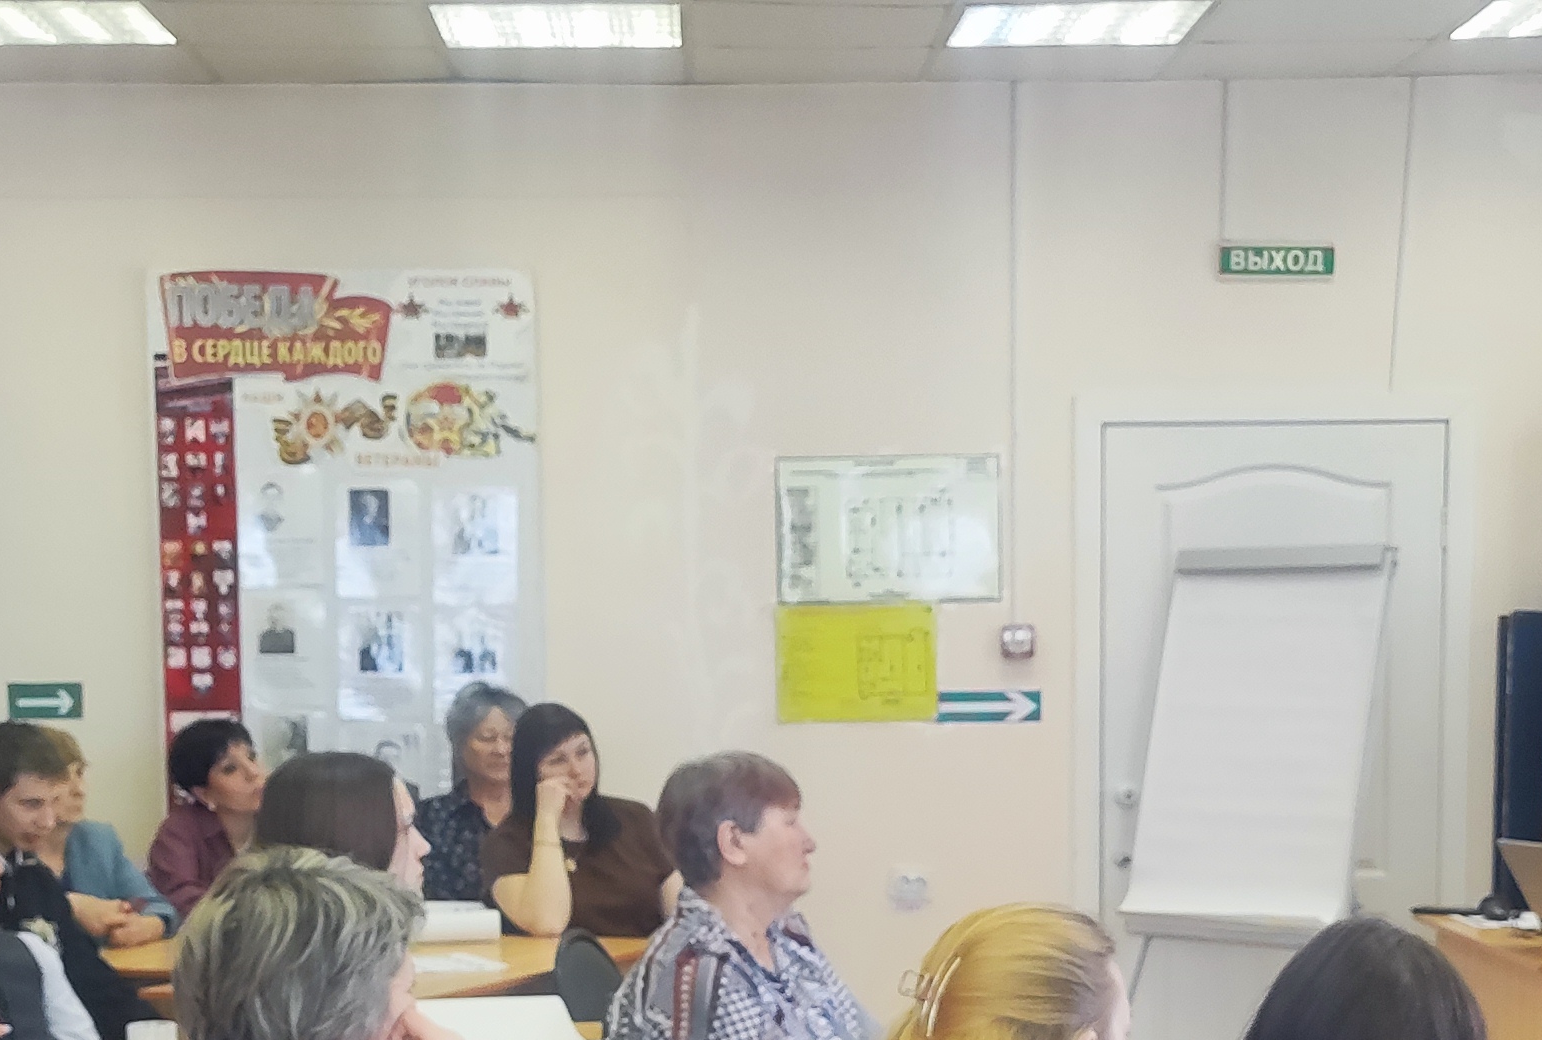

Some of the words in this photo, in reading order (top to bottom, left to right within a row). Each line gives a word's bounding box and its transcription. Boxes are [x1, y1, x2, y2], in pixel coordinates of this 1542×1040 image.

[1229, 249, 1325, 272] ВЫХОД
[168, 283, 318, 338] ПОБЕДА
[172, 338, 188, 364] В
[191, 338, 273, 368] СЕРДЦЕ
[276, 339, 382, 368] КАЖДОГО
